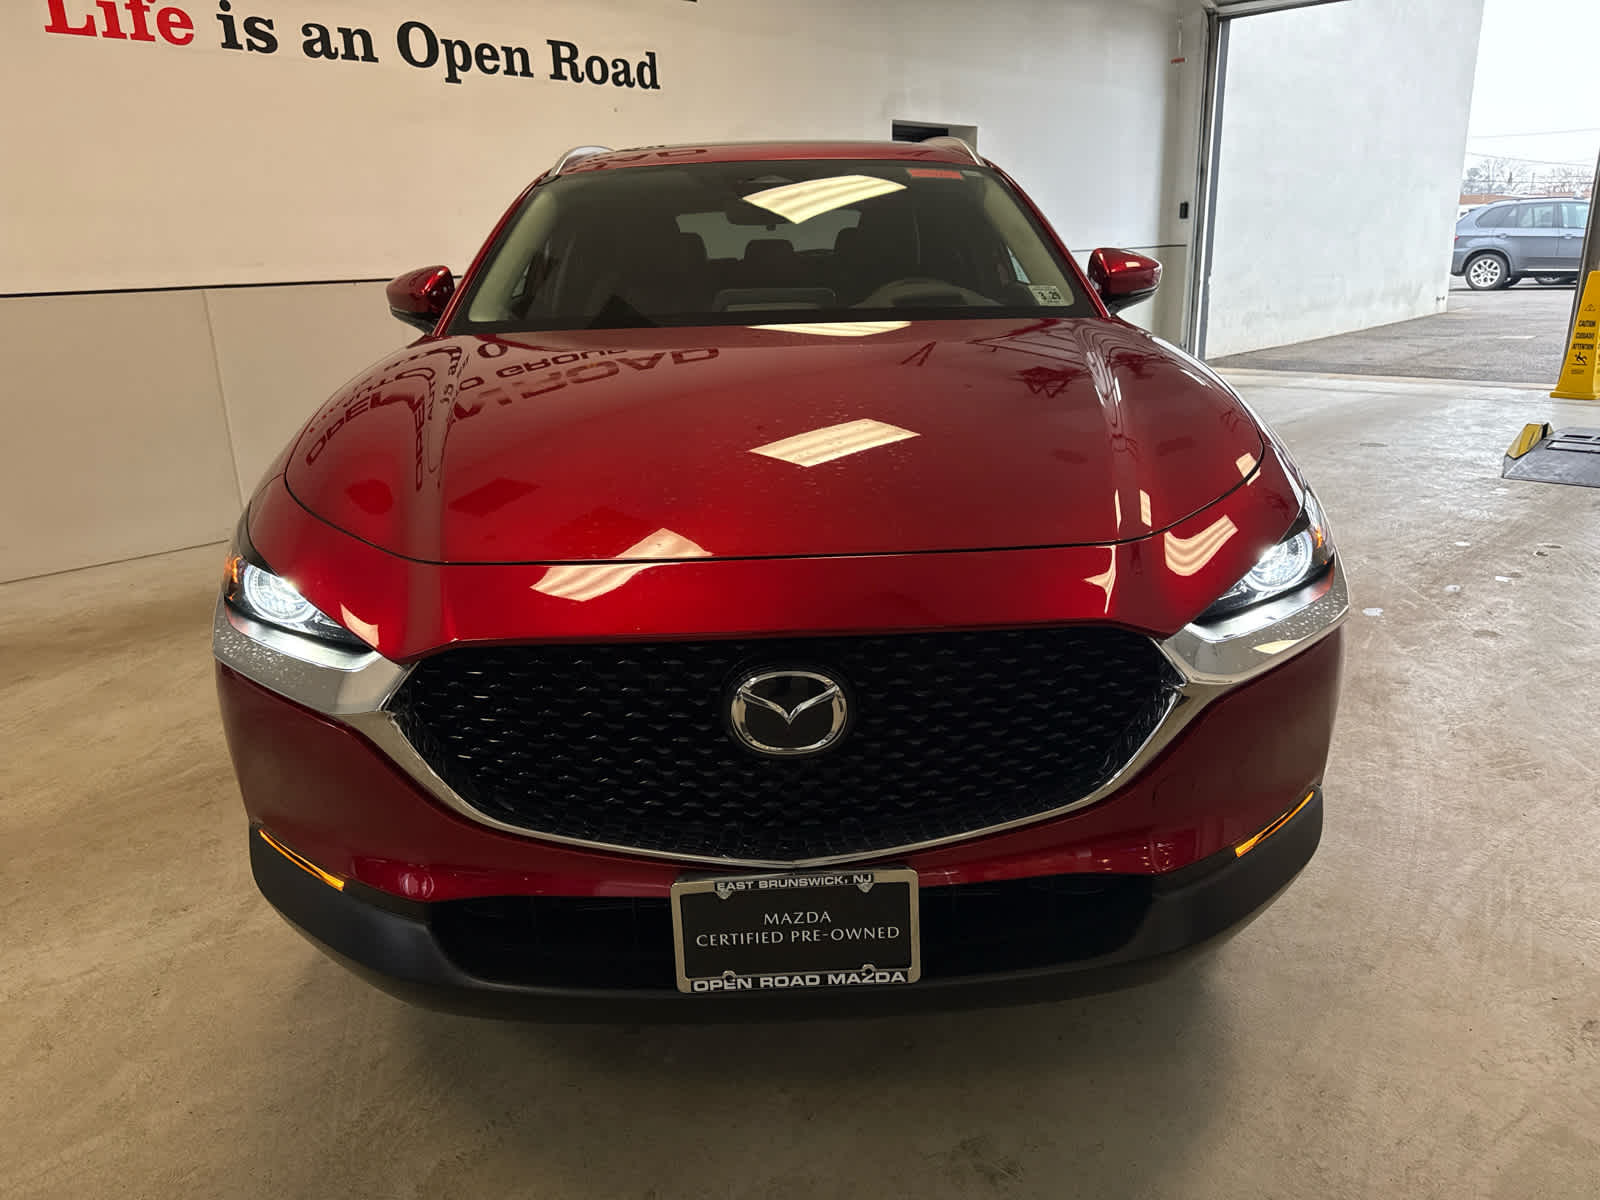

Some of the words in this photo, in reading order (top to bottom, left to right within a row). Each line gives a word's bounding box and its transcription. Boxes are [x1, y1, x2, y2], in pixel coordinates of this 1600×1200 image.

[44, 0, 194, 46] Life
[216, 0, 279, 54] is
[301, 23, 379, 63] an
[397, 21, 534, 84] Open
[547, 39, 661, 90] Road
[716, 881, 754, 891] EAST
[758, 876, 848, 889] BRUNSWICK,
[853, 874, 872, 883] NJ
[763, 911, 832, 926] MAZDA
[696, 931, 783, 947] CERTIFIED
[791, 926, 900, 943] PRE-OWNED
[693, 978, 753, 992] OPEN
[759, 974, 820, 988] ROAD
[827, 972, 906, 985] MAZDA
